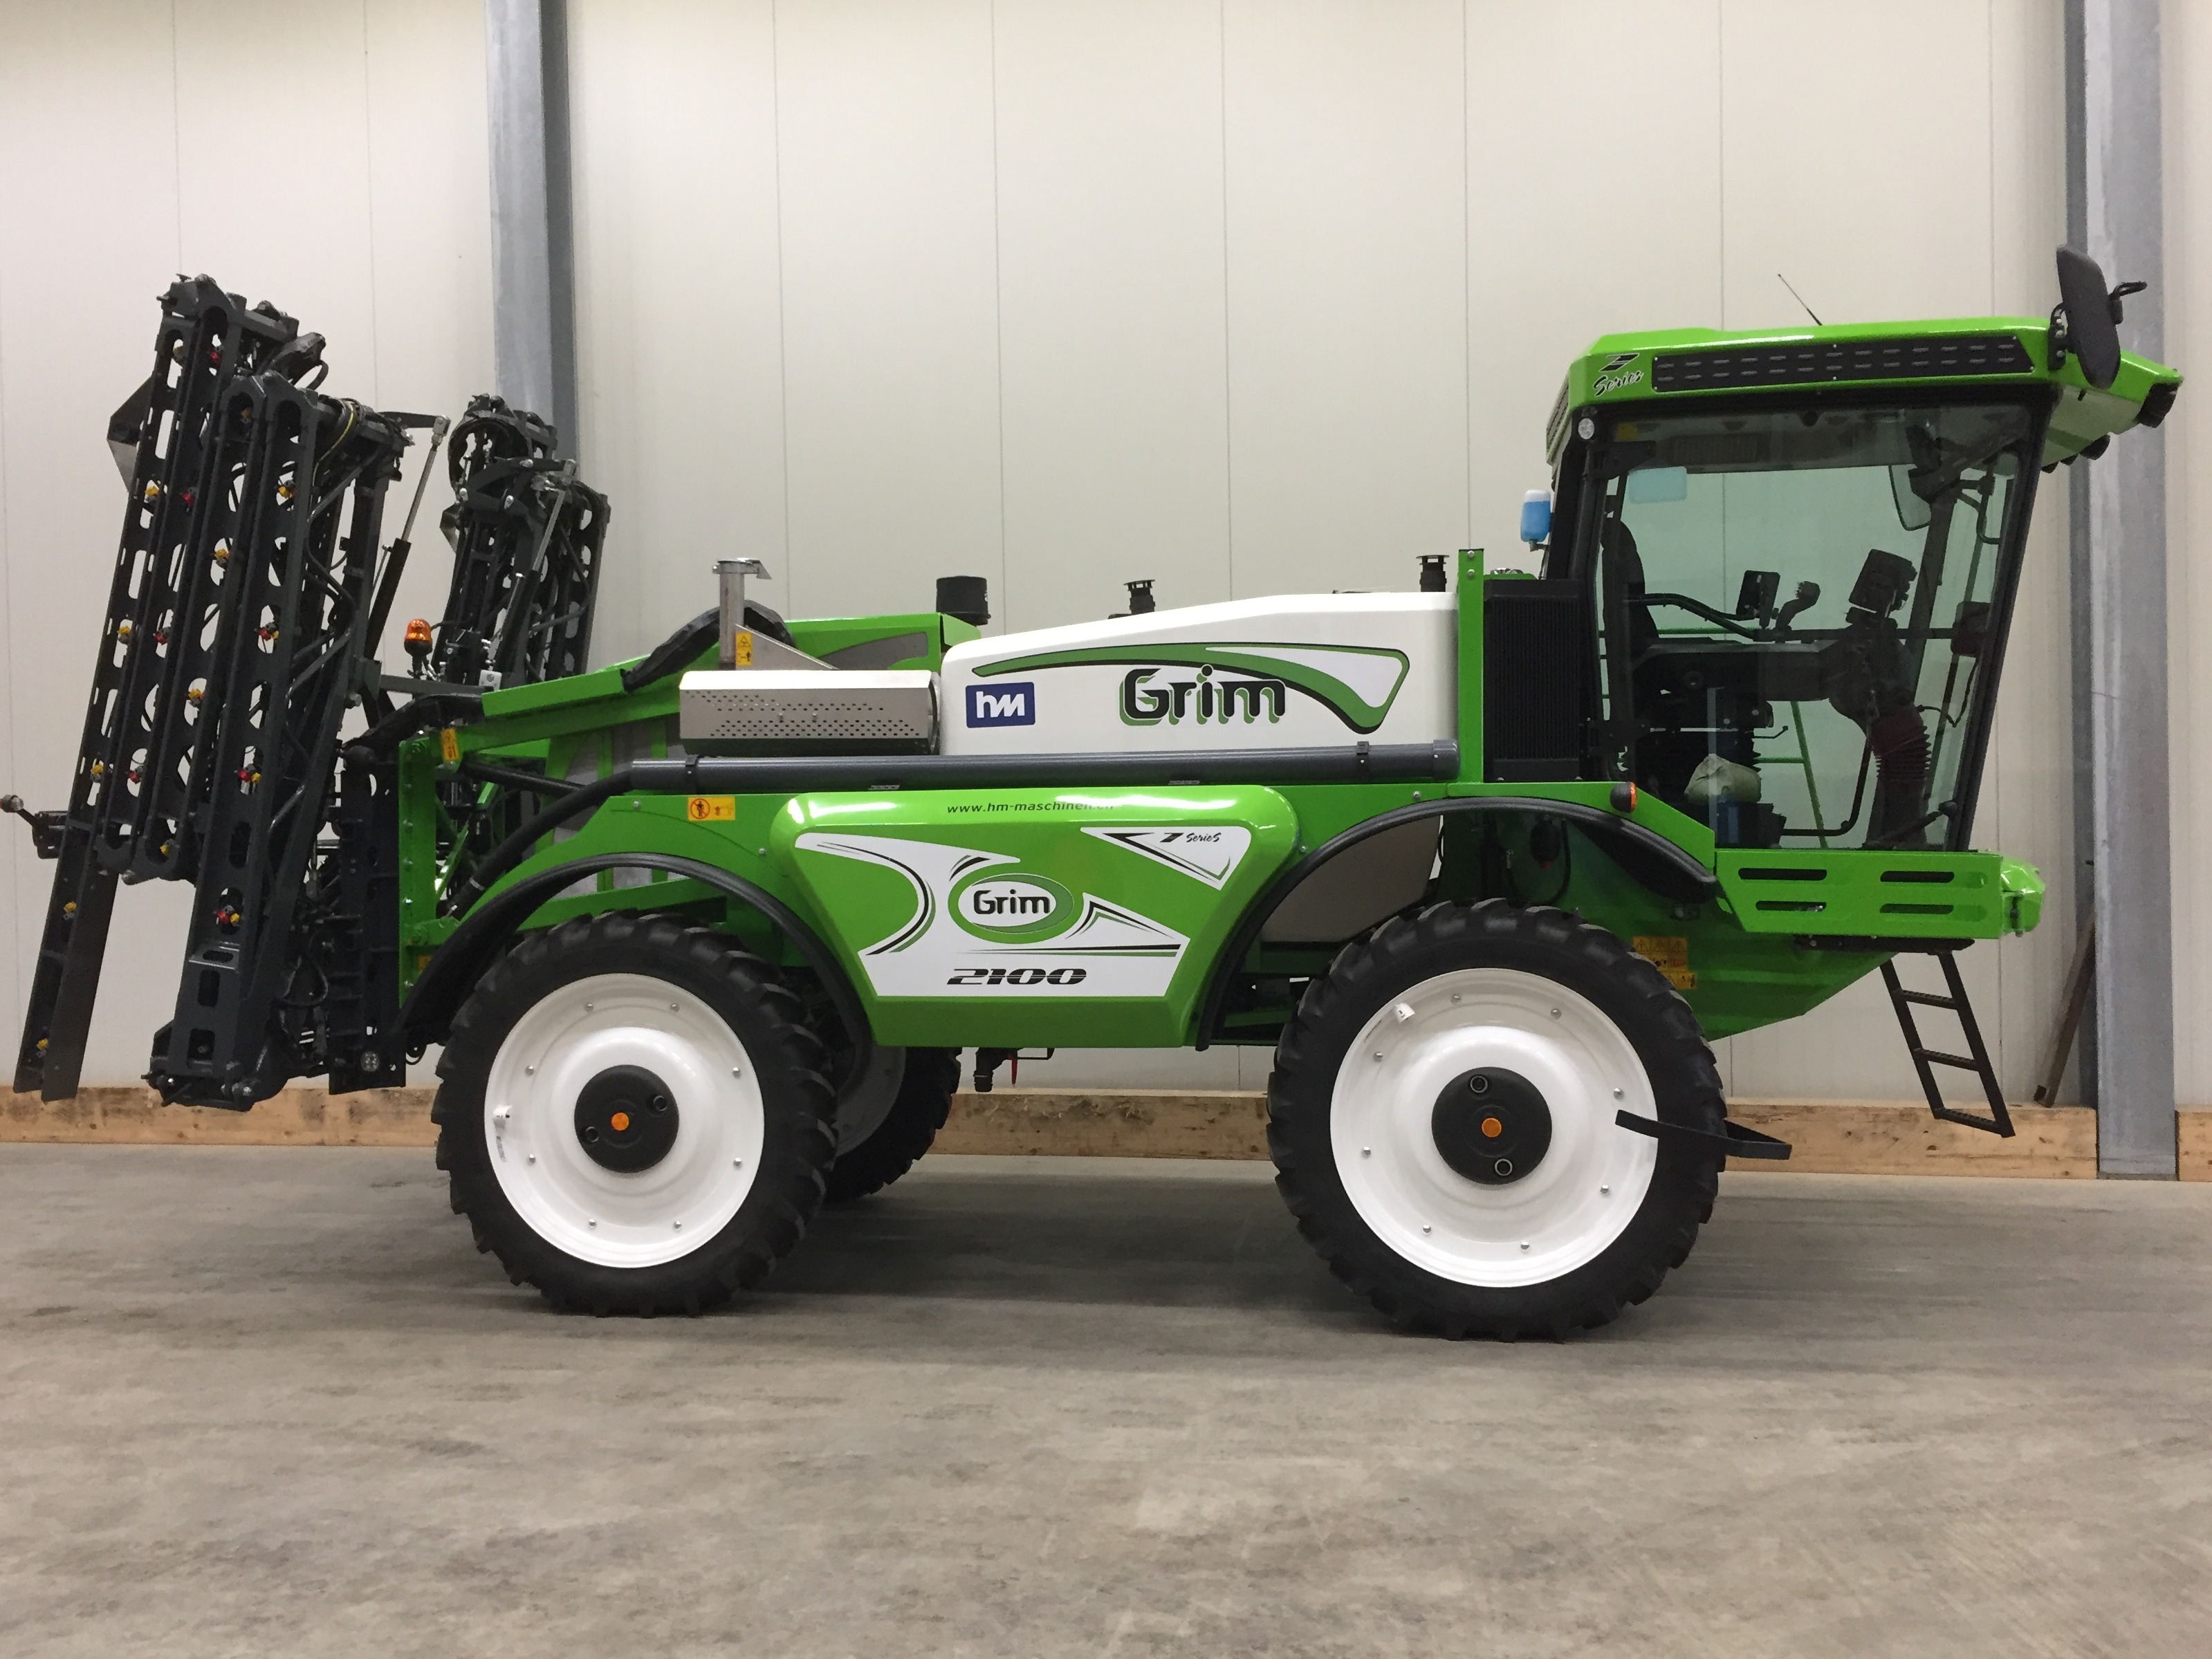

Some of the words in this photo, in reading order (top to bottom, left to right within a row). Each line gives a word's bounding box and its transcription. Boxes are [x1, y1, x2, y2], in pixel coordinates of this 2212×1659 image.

[1593, 370, 1644, 397] Series
[1119, 664, 1286, 726] Grim
[973, 889, 1050, 915] Grim
[947, 968, 1087, 985] 2100
